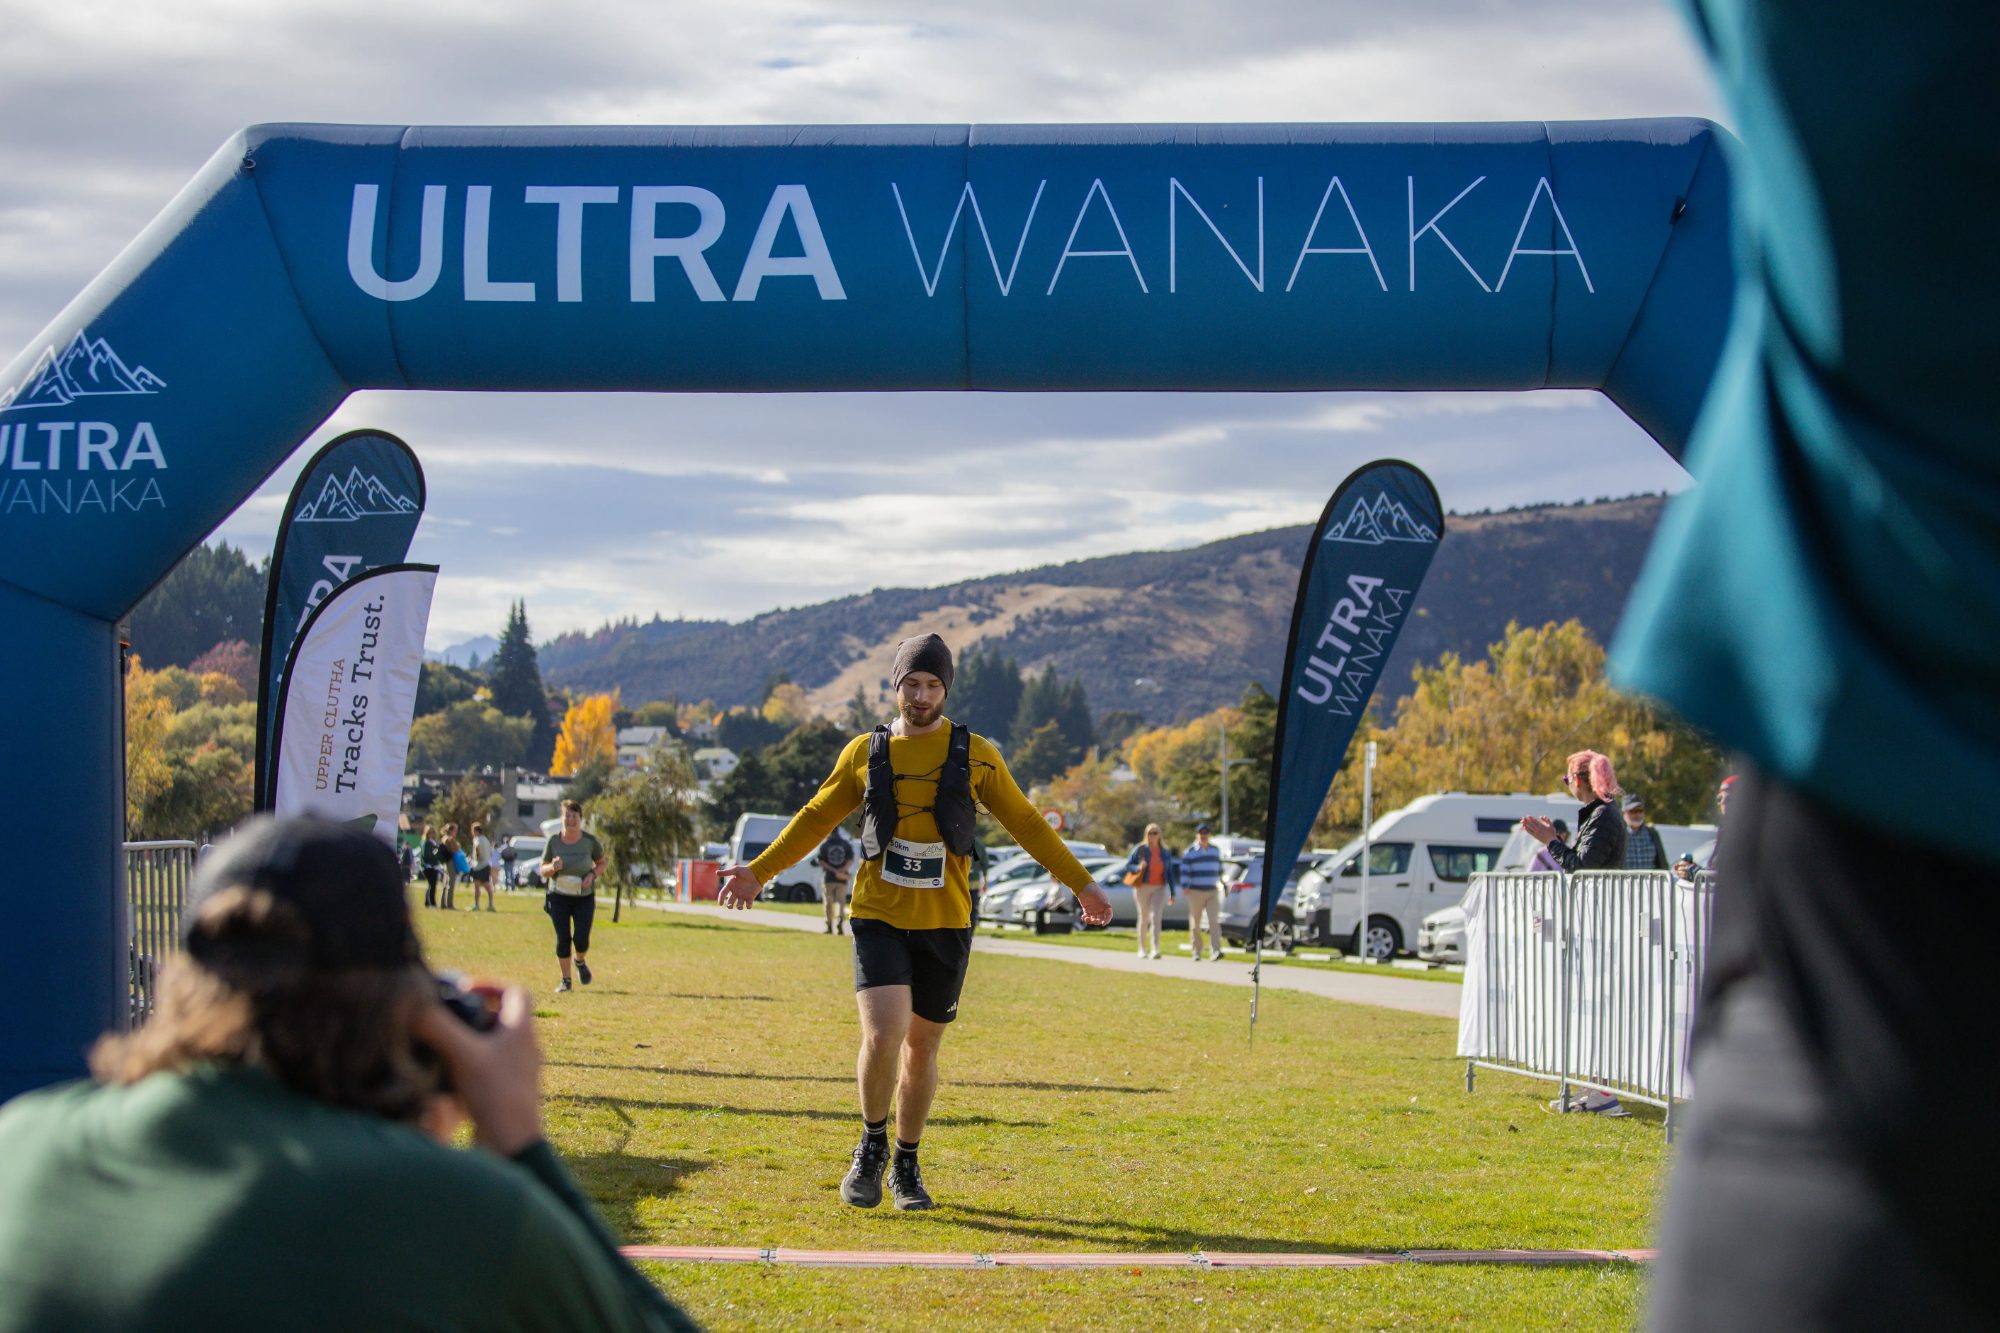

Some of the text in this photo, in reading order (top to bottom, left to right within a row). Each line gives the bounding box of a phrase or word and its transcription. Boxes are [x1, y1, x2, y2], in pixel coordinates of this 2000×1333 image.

[347, 174, 1595, 303] ULTRA WANAKA
[0, 476, 167, 515] ANAKA
[335, 594, 385, 794] Tracks Trust.
[1297, 573, 1385, 705] ULTRA
[1328, 587, 1412, 717] WANAKA
[315, 657, 346, 791] UPPER CLUTHA
[902, 857, 923, 872] 33
